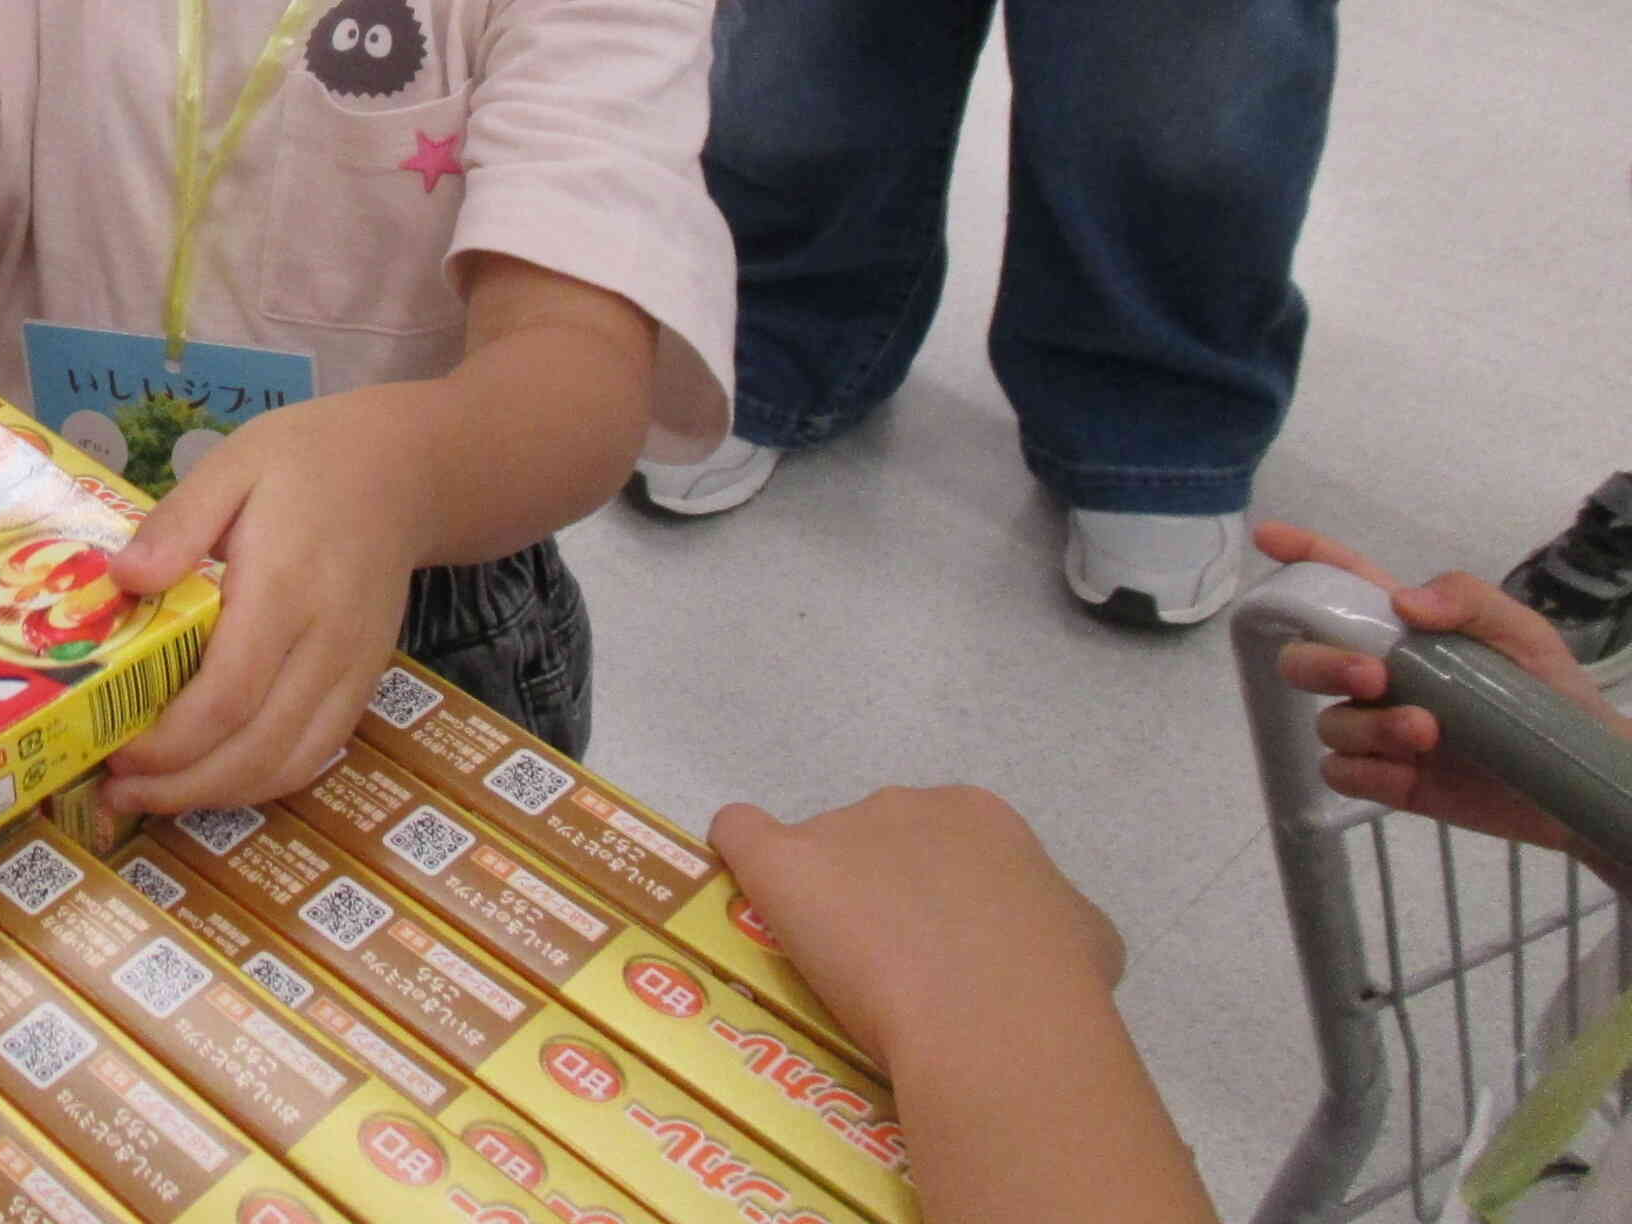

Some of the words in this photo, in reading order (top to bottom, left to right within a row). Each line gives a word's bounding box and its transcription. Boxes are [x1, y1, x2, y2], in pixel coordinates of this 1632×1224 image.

[550, 820, 679, 906] おいしさのヒミツは
[596, 830, 652, 867] こちら
[446, 878, 574, 967] おいしさのヒミツは
[492, 886, 547, 924] こちら
[364, 954, 491, 1050] おいしさのヒミツは
[411, 964, 465, 1005] こちら
[632, 964, 704, 1015] 甘口
[178, 1024, 309, 1131] おいしさのヒミツは
[227, 1034, 283, 1080] こちら
[552, 1048, 619, 1101] 甘口
[705, 1019, 912, 1160] デンカレー
[62, 1093, 189, 1201] おいしさのヒミツは
[111, 1104, 166, 1151] こちら
[367, 1123, 436, 1182] 甘口
[626, 1107, 811, 1224] デンカレー
